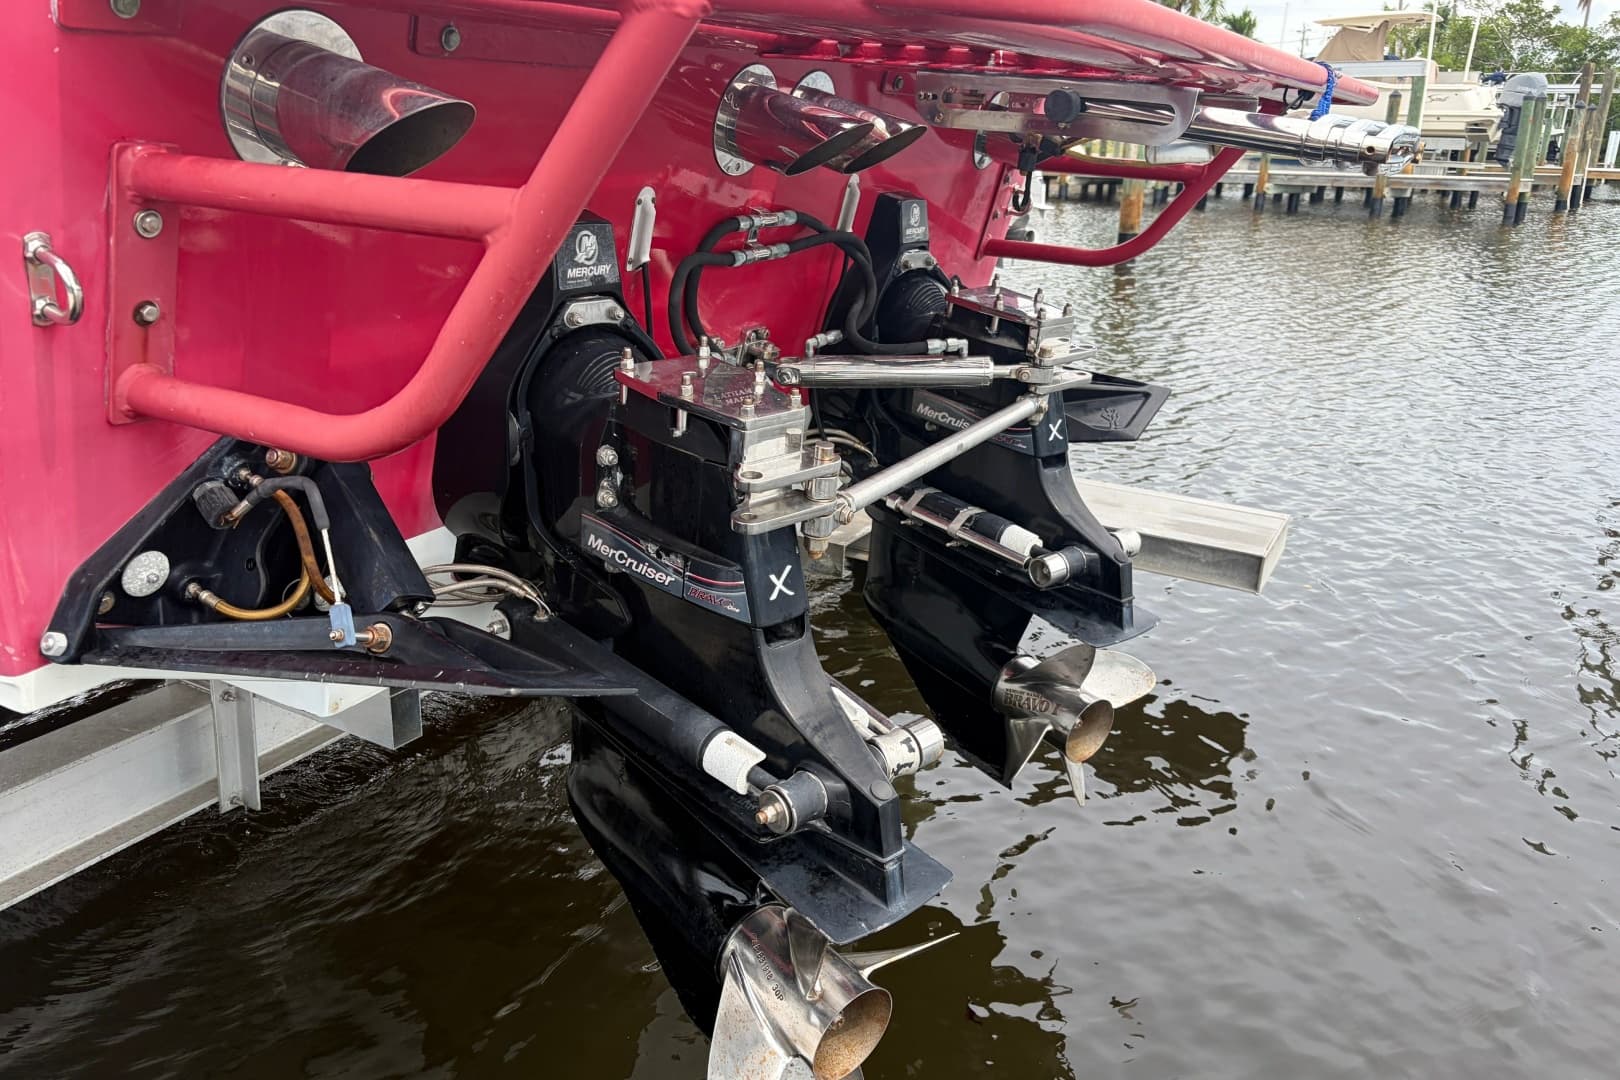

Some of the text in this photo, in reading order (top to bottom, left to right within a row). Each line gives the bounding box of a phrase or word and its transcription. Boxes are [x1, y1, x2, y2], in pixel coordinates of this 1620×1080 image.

[567, 264, 612, 279] MERCURY
[916, 402, 971, 431] MerCruis
[587, 533, 676, 586] MerCruiser
[769, 564, 795, 600] X
